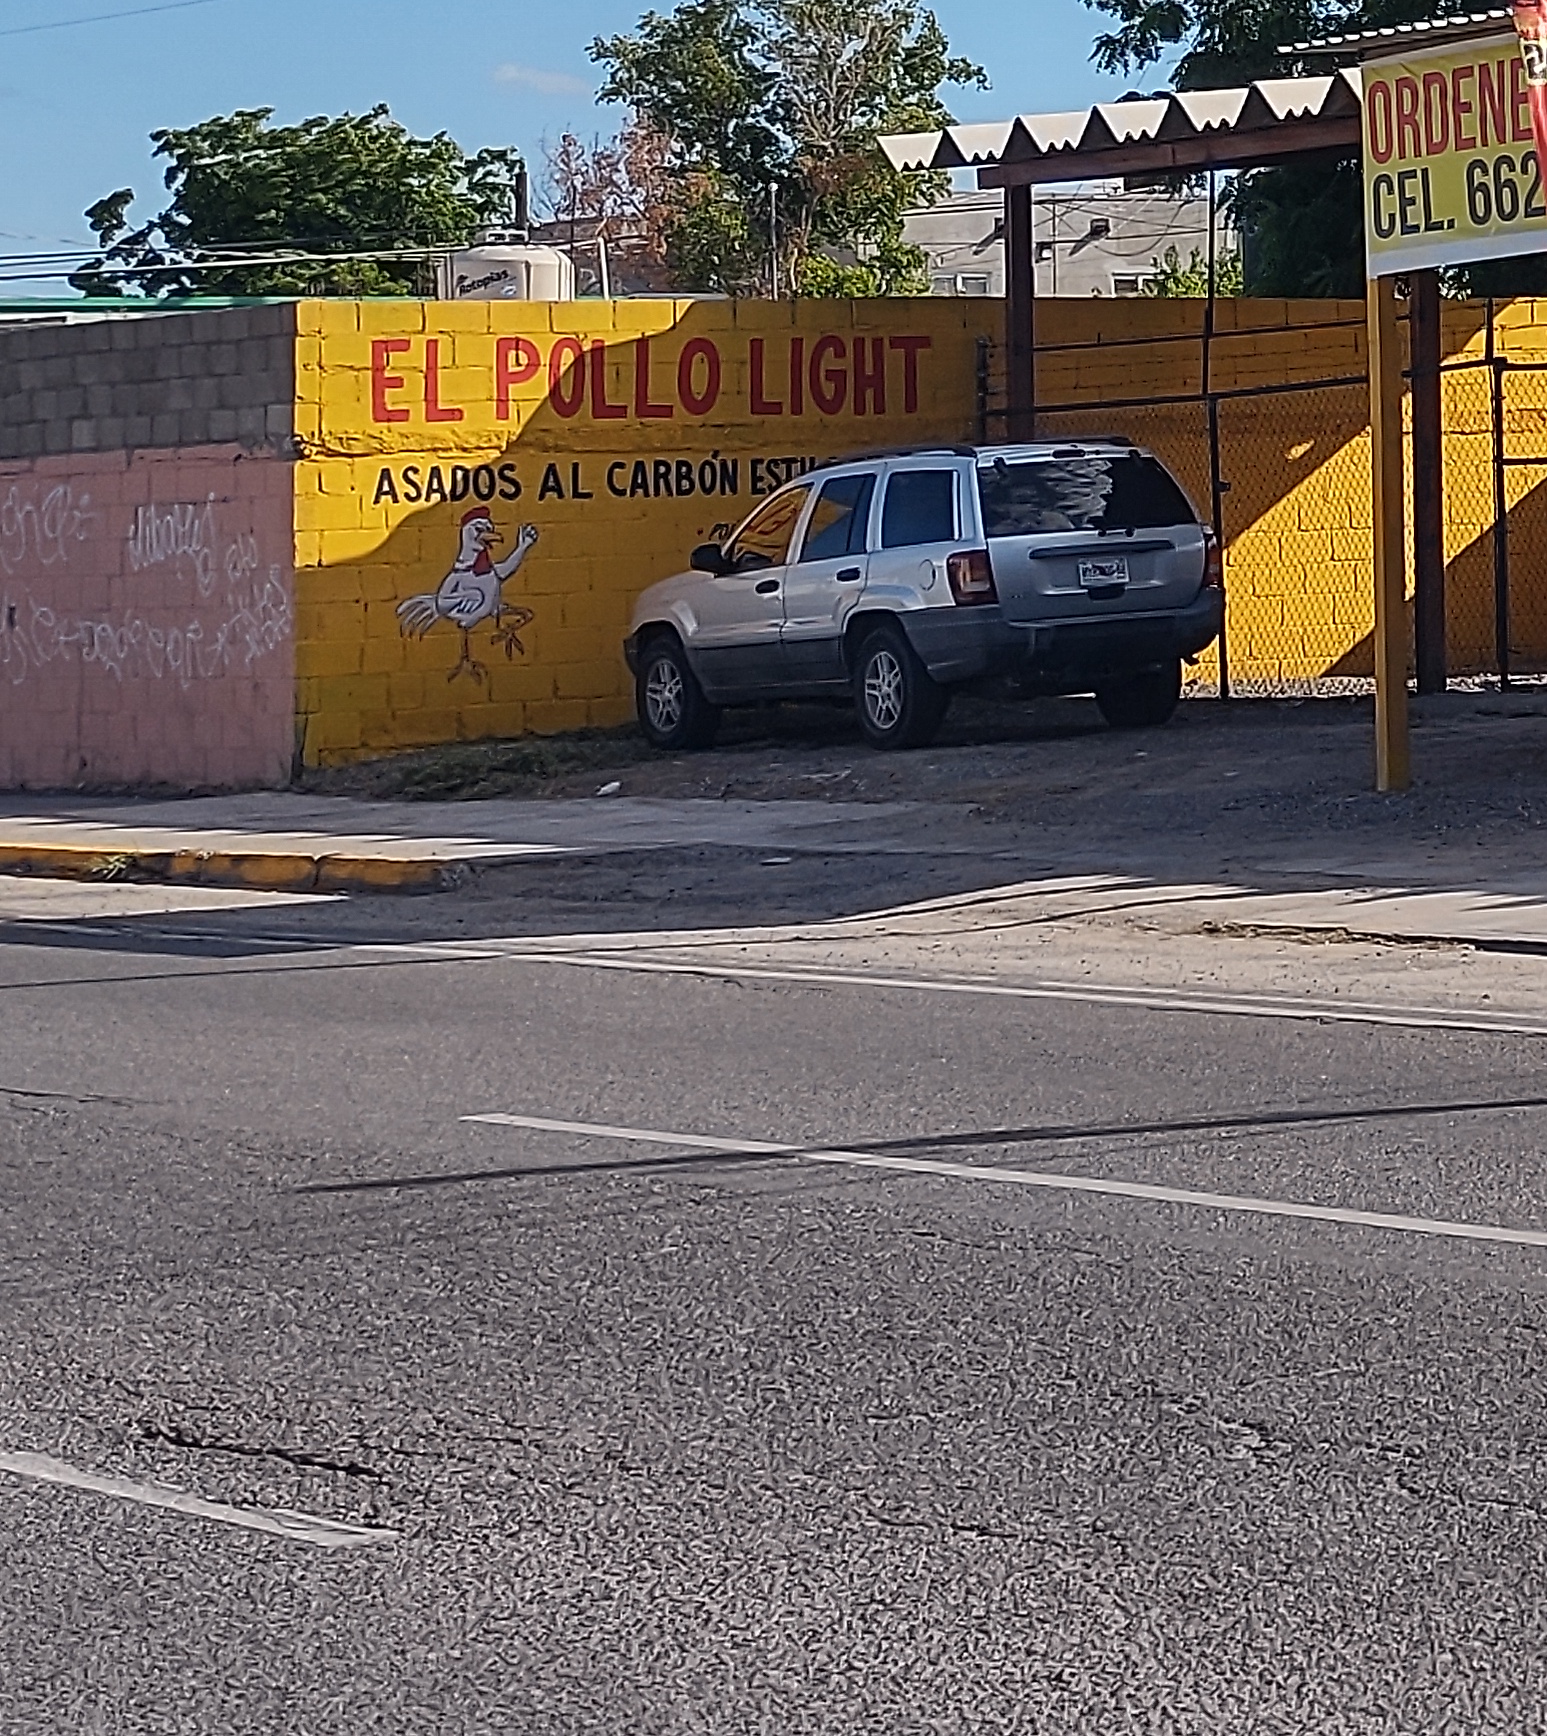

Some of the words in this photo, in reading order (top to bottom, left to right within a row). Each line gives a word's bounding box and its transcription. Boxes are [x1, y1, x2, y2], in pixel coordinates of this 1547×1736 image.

[1372, 168, 1456, 239] CEL.
[371, 338, 463, 423] EL
[495, 336, 721, 421] POLLO
[750, 335, 931, 417] LIGHT
[373, 463, 523, 504] ASADOS
[538, 462, 593, 501] AL
[606, 450, 738, 498] CARBÓN
